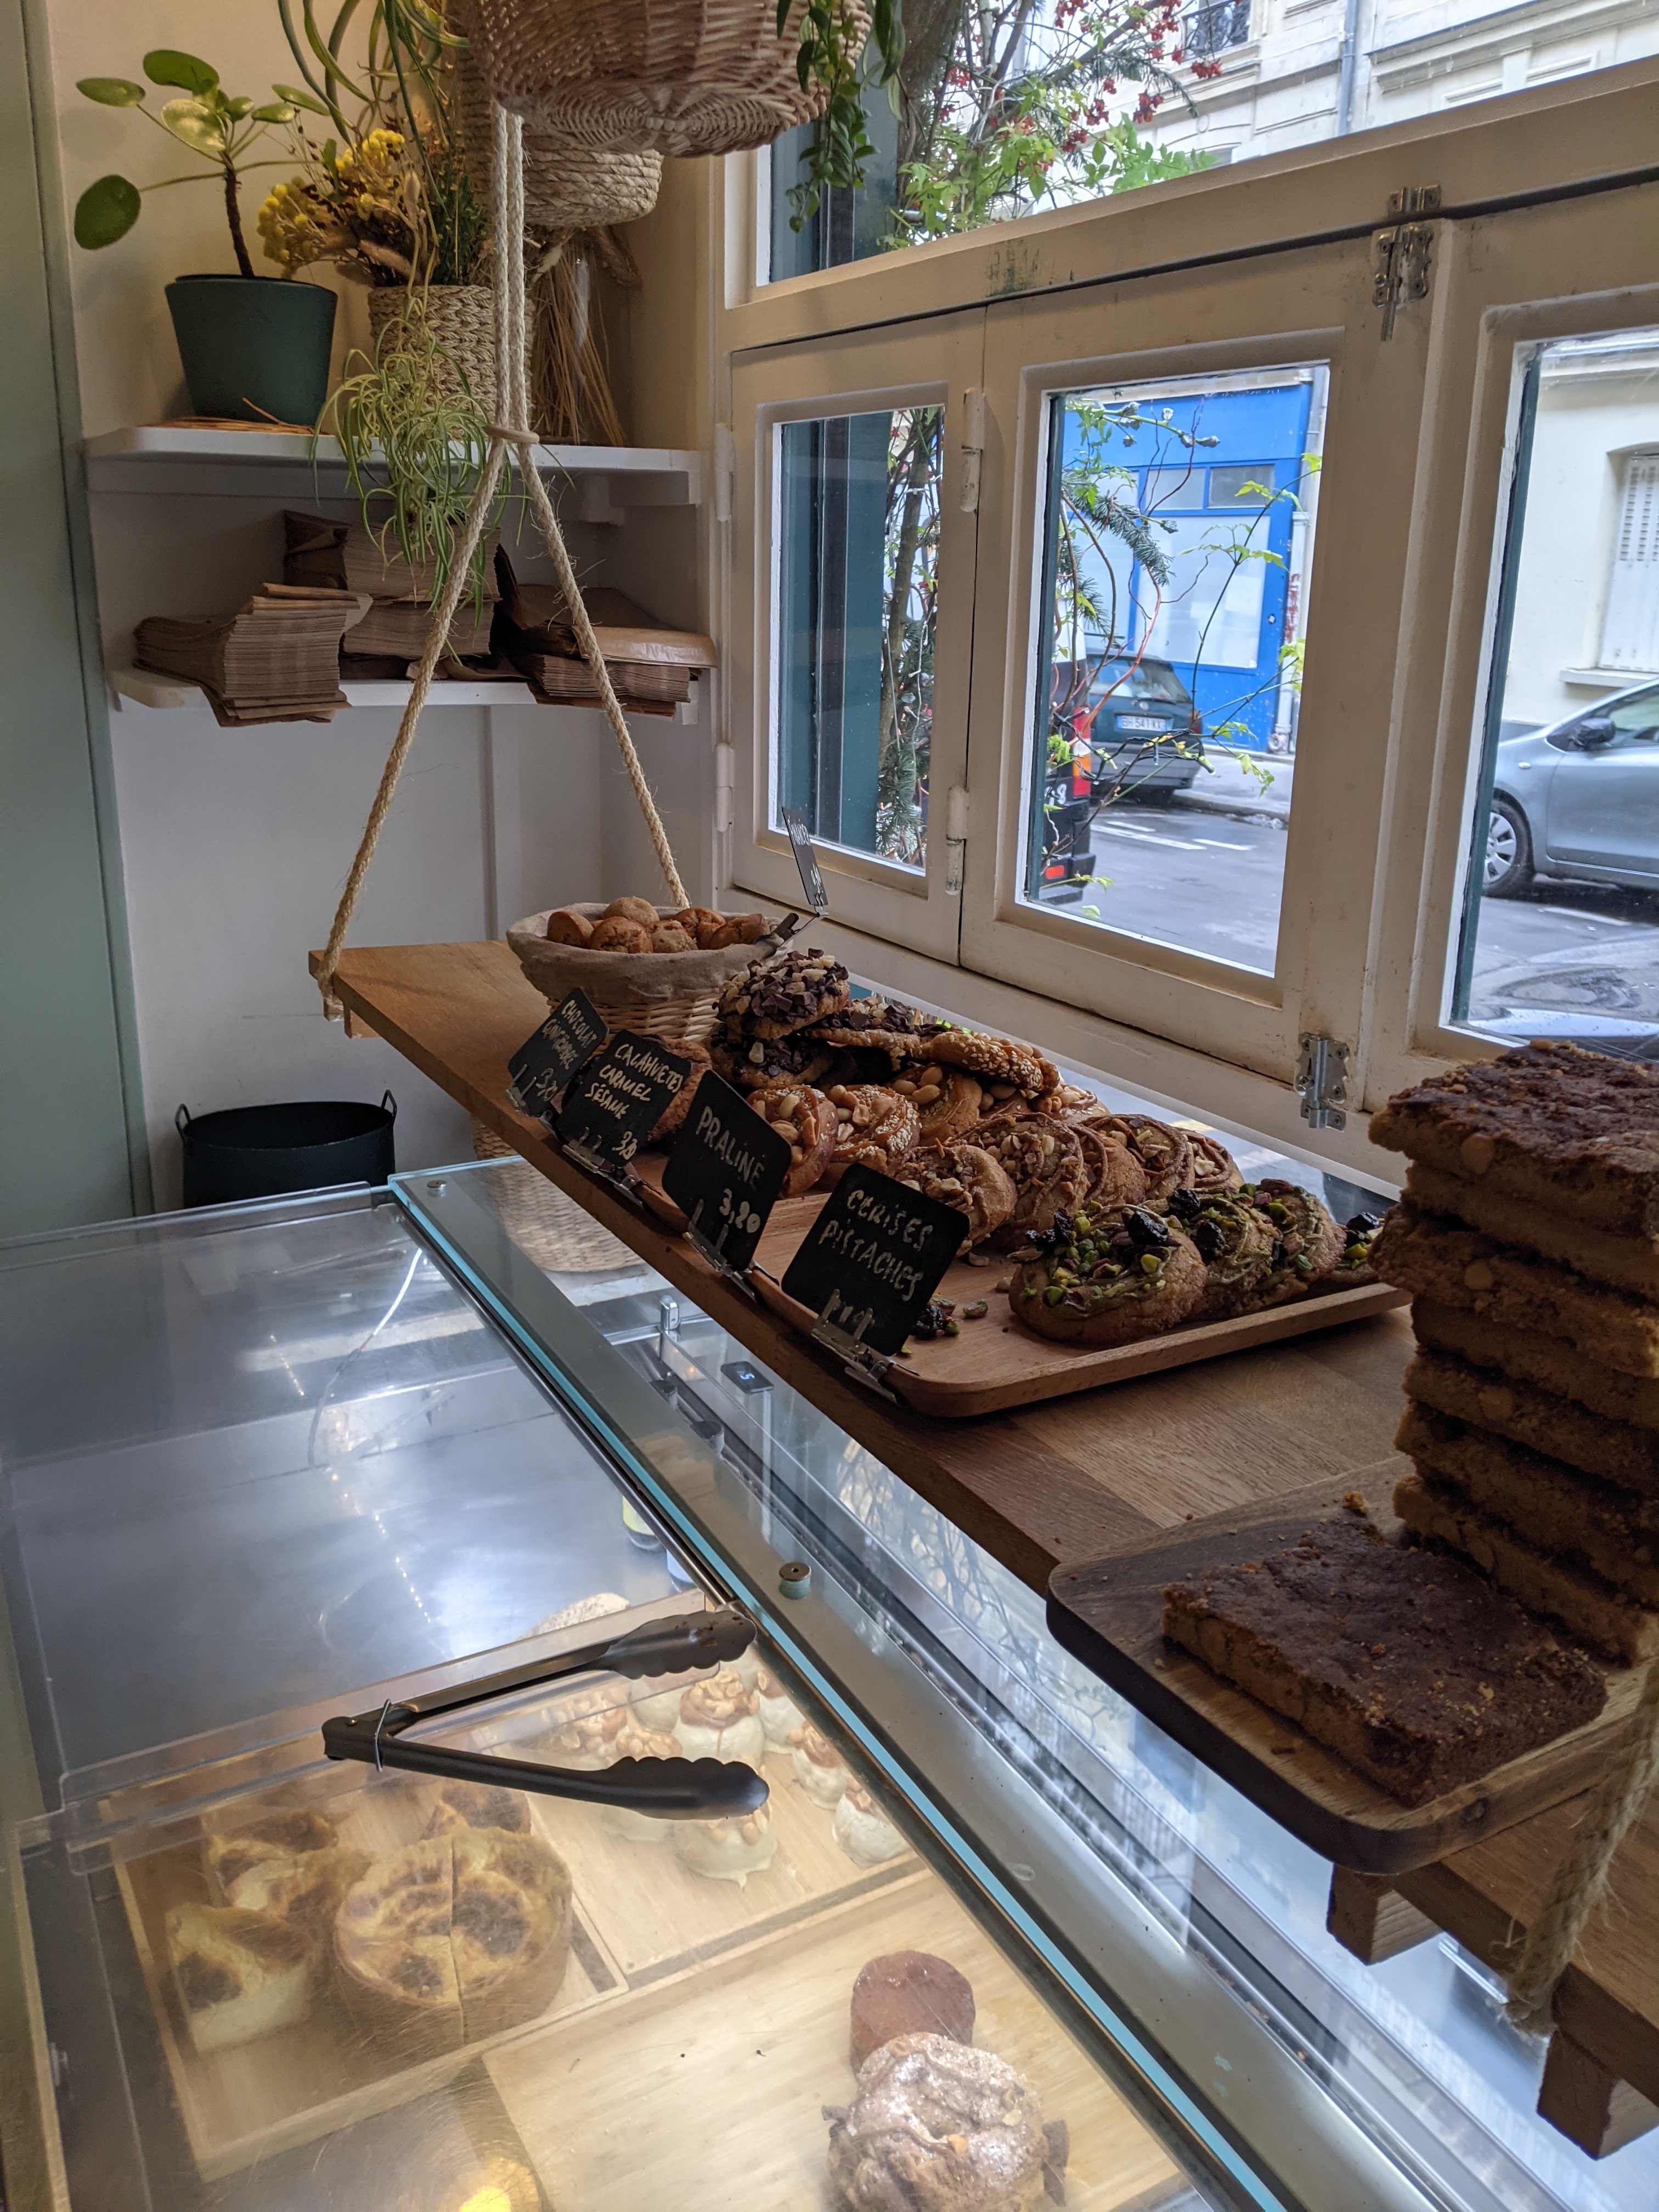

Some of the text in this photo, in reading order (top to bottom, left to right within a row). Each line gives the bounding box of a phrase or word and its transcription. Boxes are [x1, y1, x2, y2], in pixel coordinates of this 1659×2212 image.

[561, 999, 598, 1048] CHOCOLAT
[599, 1064, 652, 1102] CARAMEL
[719, 1187, 761, 1234] 3,20
[847, 1189, 933, 1252] CERISES
[818, 1219, 924, 1302] PISTACHES
